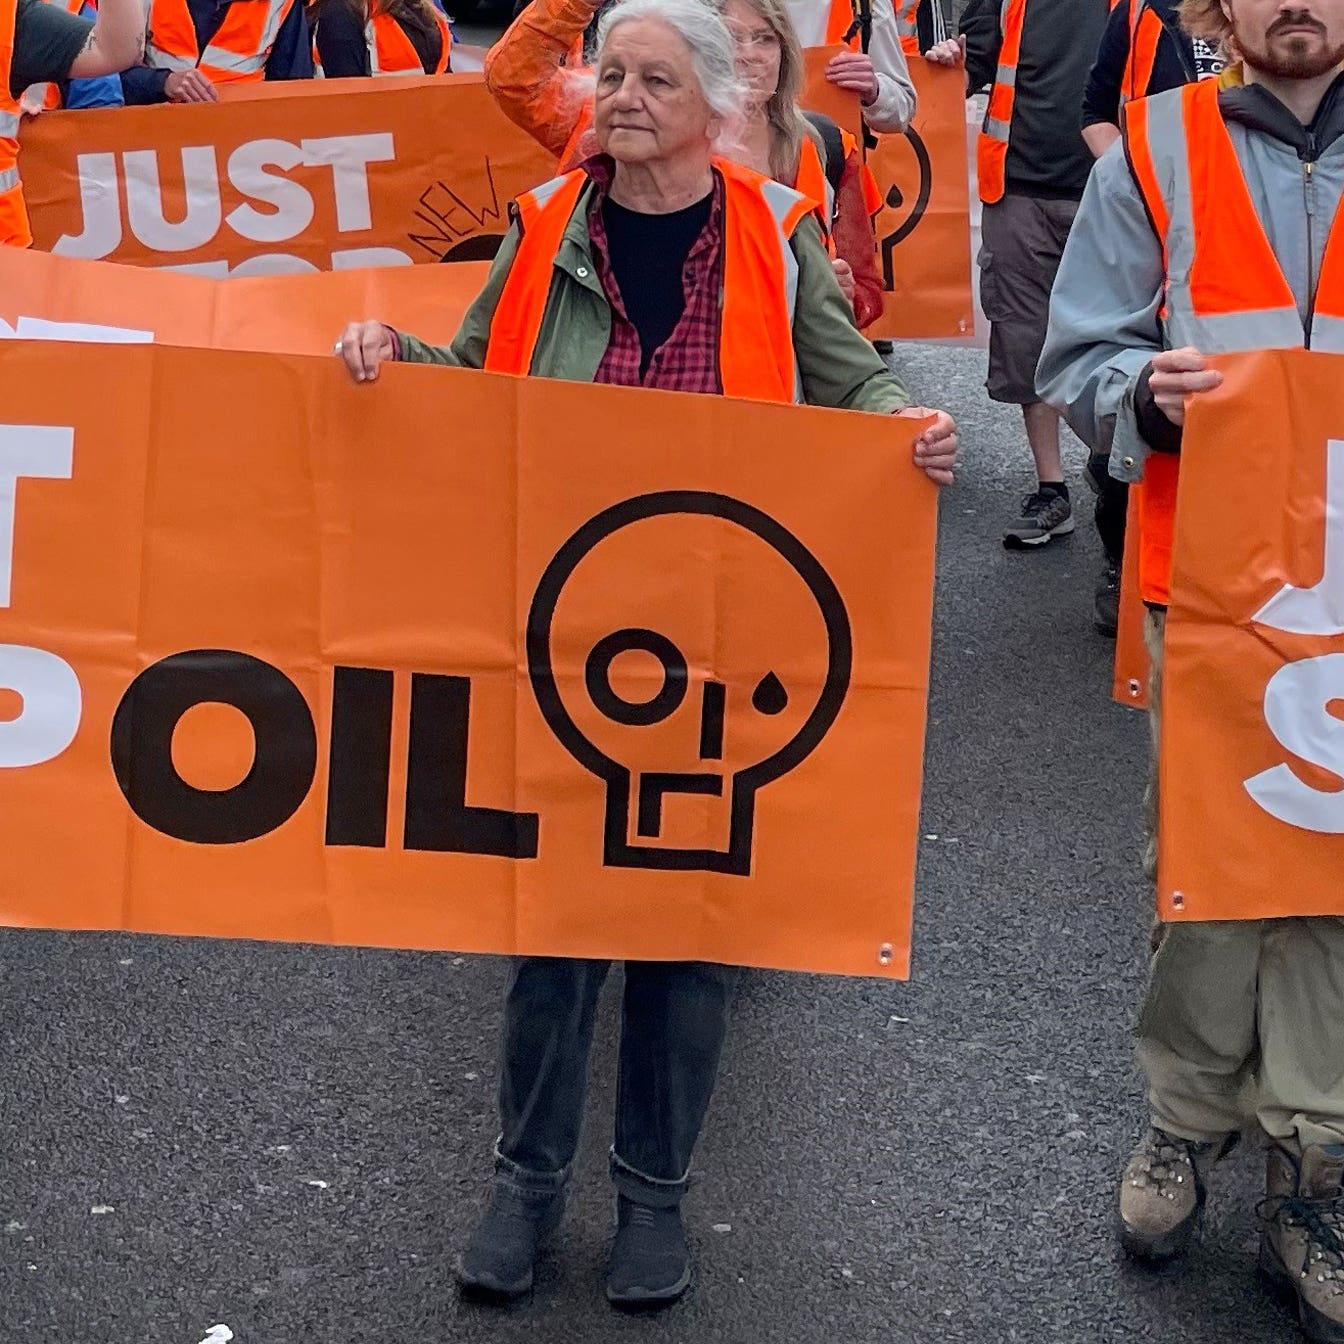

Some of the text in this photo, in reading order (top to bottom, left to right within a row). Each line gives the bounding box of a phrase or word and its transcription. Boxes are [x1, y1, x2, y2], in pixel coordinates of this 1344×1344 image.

[52, 132, 396, 258] JUST
[408, 155, 500, 257] NEW
[110, 649, 539, 858] OIL
